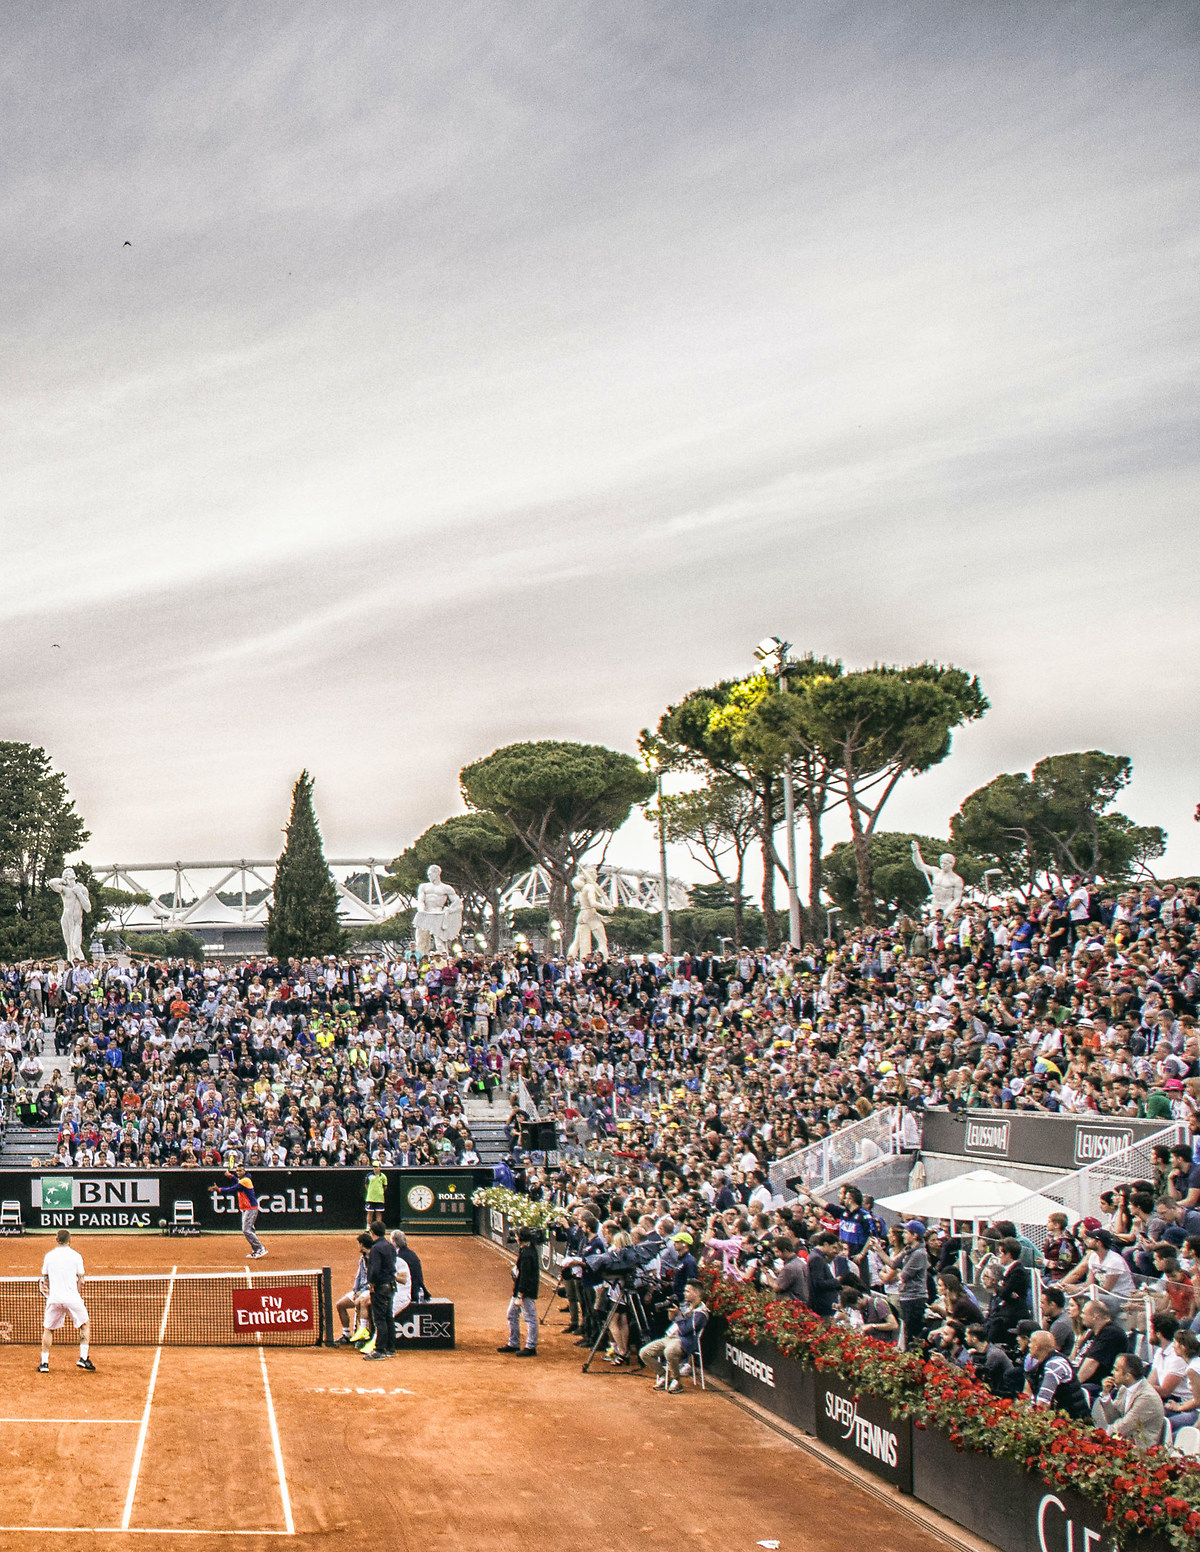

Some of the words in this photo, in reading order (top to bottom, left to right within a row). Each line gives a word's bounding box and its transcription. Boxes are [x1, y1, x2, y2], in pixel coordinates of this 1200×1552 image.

[967, 1122, 1008, 1150] LEVISSIMA
[79, 1182, 150, 1204] BNL
[211, 1187, 323, 1213] ticali:
[41, 1213, 74, 1226] BNP
[79, 1213, 151, 1226] PARIBAS
[261, 1296, 282, 1309] Fly
[237, 1307, 309, 1326] Emirates
[395, 1314, 451, 1338] edEx
[725, 1343, 776, 1388] POWERADE
[825, 1391, 854, 1427] SUPER
[854, 1413, 898, 1468] TENNIS
